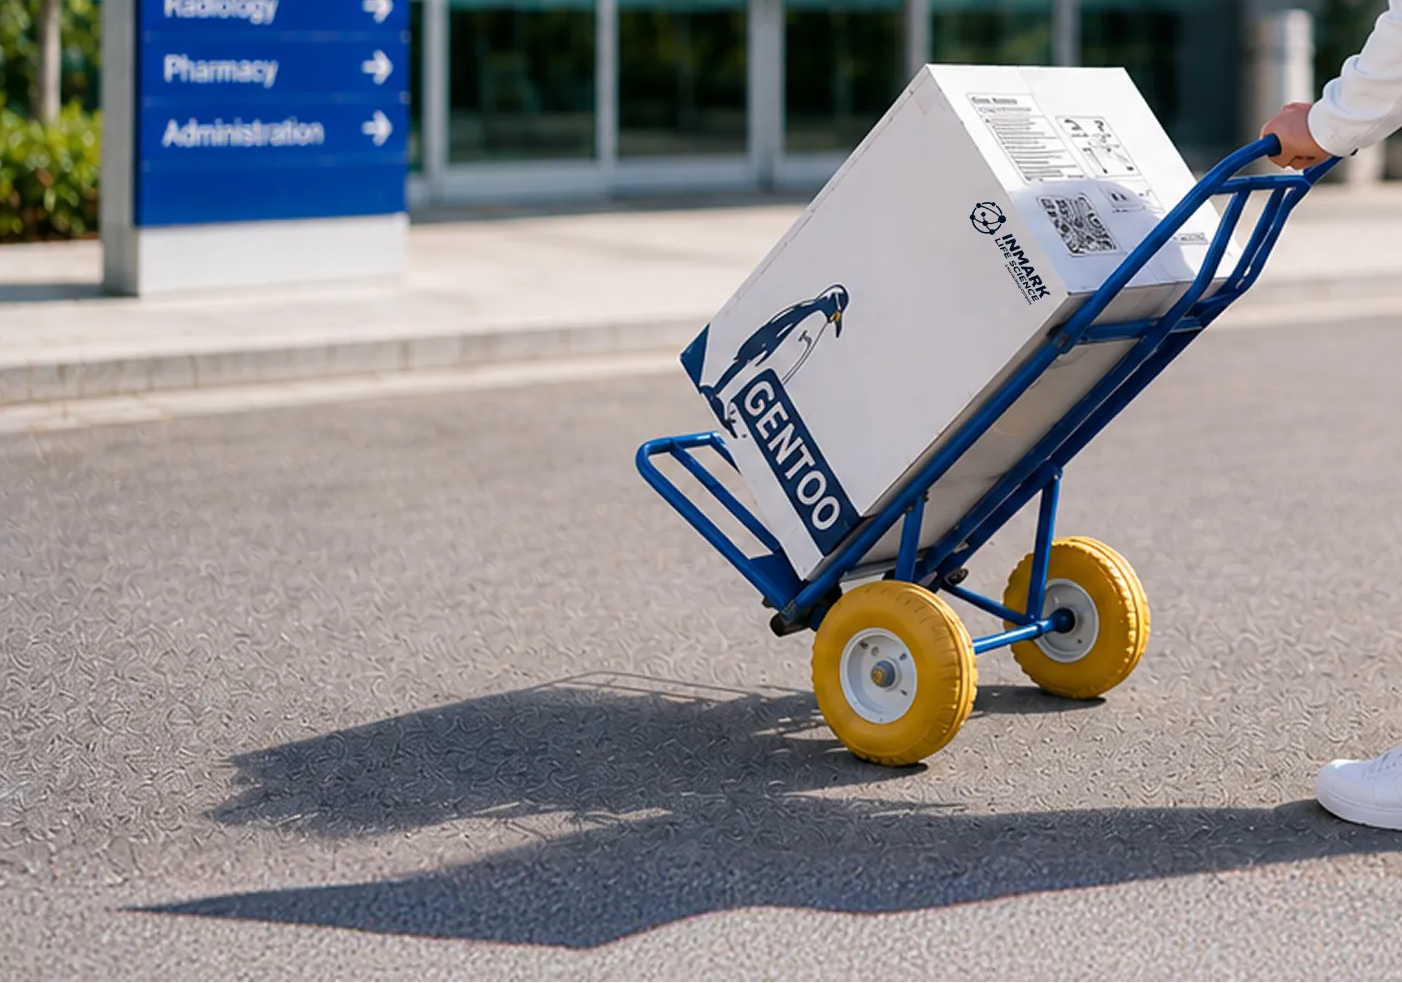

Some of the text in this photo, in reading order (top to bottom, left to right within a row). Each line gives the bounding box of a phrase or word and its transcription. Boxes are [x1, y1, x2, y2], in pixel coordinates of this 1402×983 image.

[163, 54, 279, 89] Pharmacy
[162, 116, 326, 148] Administration
[994, 237, 1012, 259] LIFE
[1008, 260, 1040, 302] SCIENCE
[1002, 233, 1051, 299] INMARK
[743, 380, 841, 531] GENTOO
